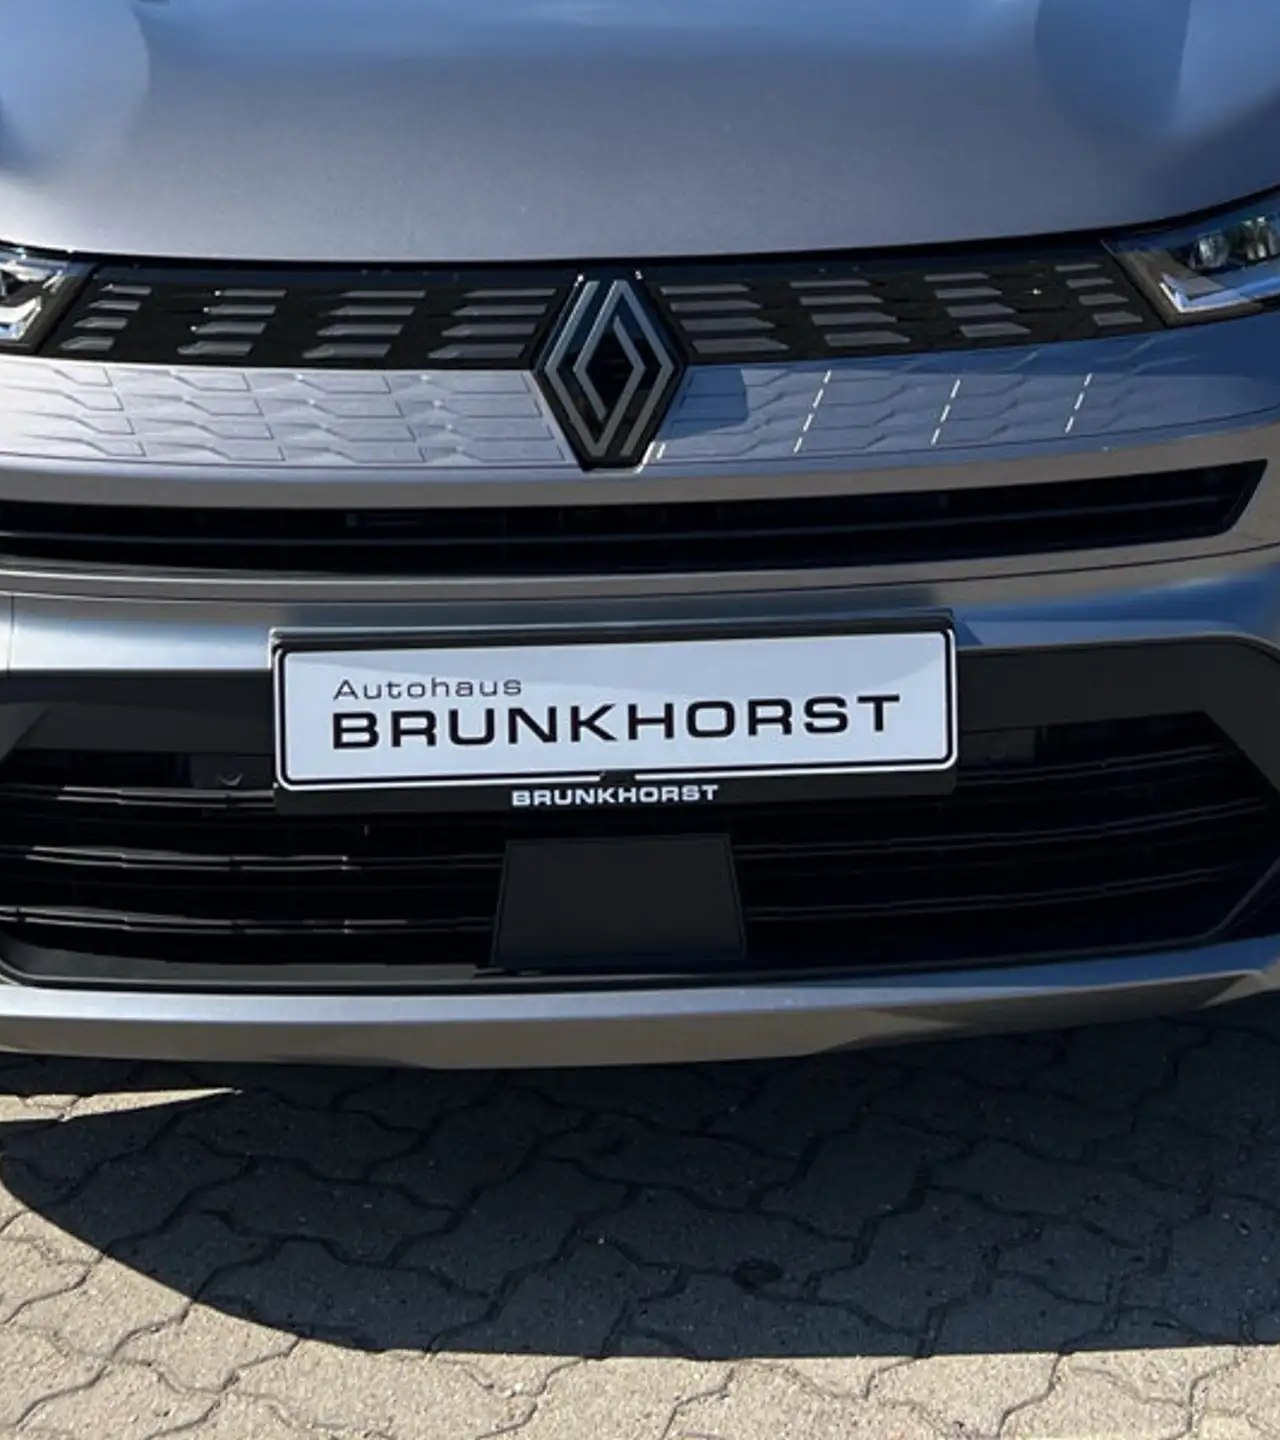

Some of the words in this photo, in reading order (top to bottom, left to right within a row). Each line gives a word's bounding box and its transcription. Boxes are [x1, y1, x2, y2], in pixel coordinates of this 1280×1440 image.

[333, 677, 523, 701] Autohaus
[332, 693, 902, 750] BRUNKHORST
[511, 783, 719, 807] BRUNKHORST
